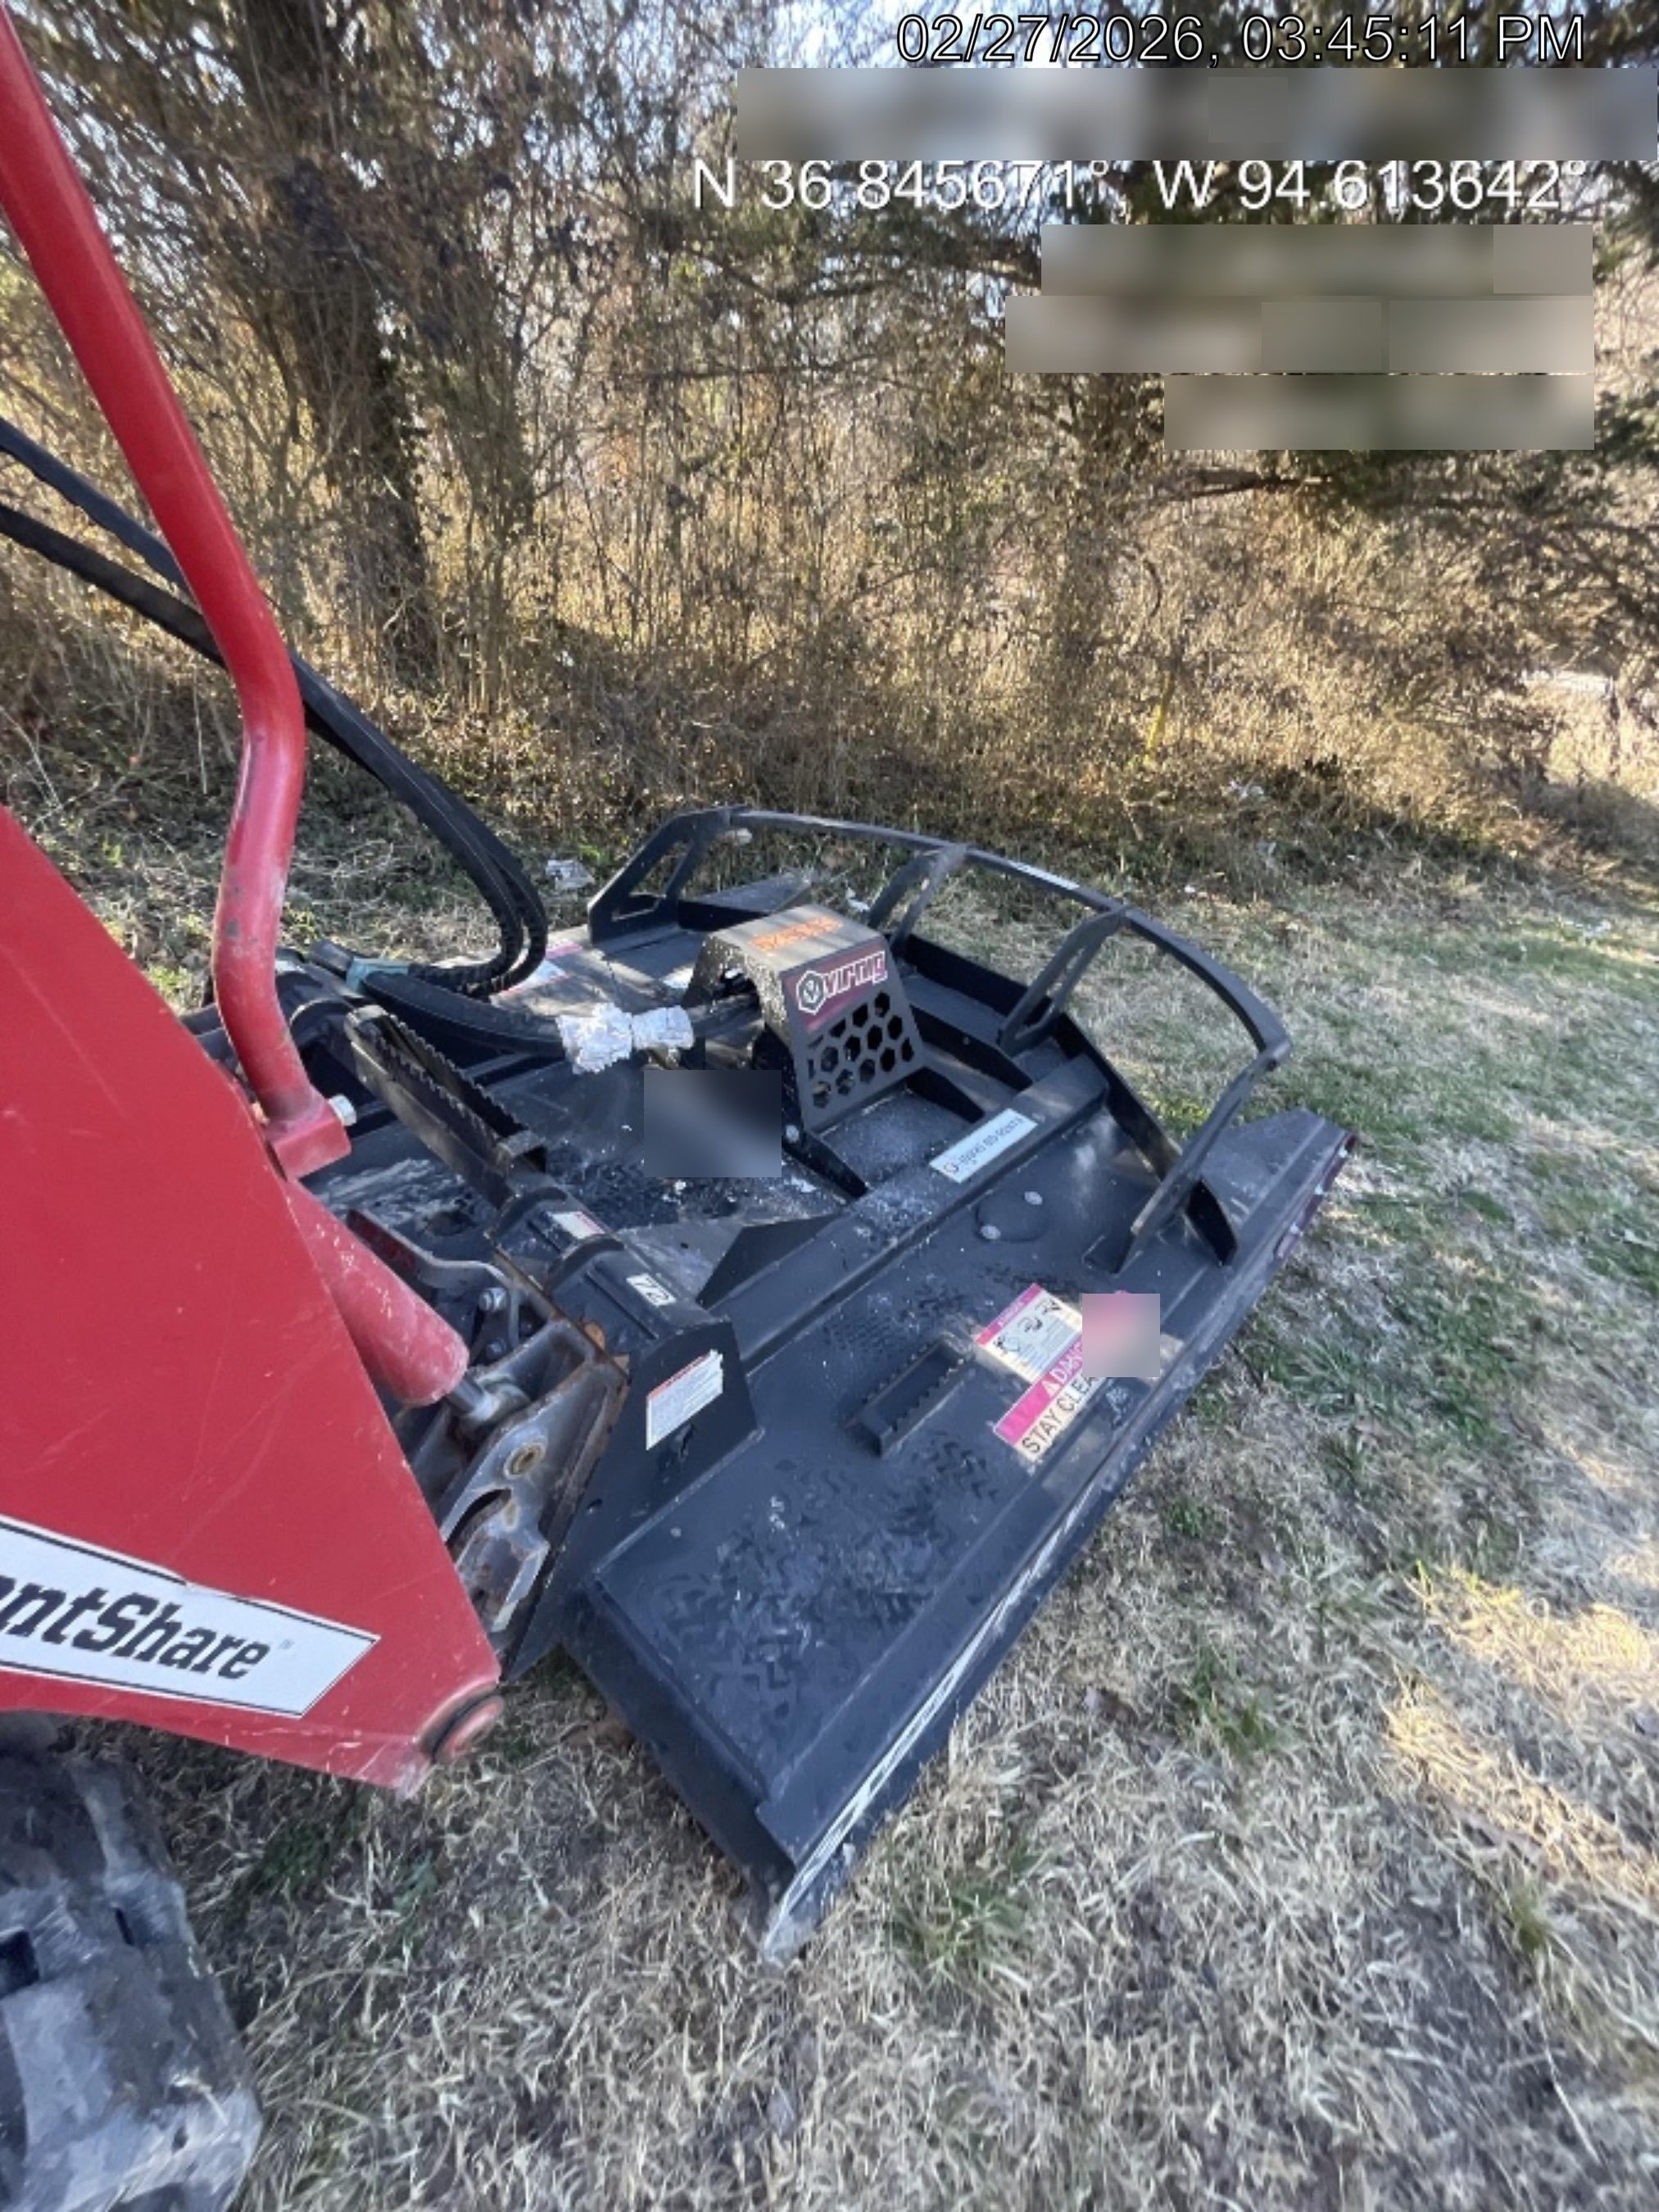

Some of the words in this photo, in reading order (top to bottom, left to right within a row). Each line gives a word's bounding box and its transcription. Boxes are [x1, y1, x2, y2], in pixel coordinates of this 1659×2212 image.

[1022, 1407, 1063, 1454] STAY
[1056, 1376, 1098, 1413] CLEA
[0, 1575, 270, 1680] ntShare
